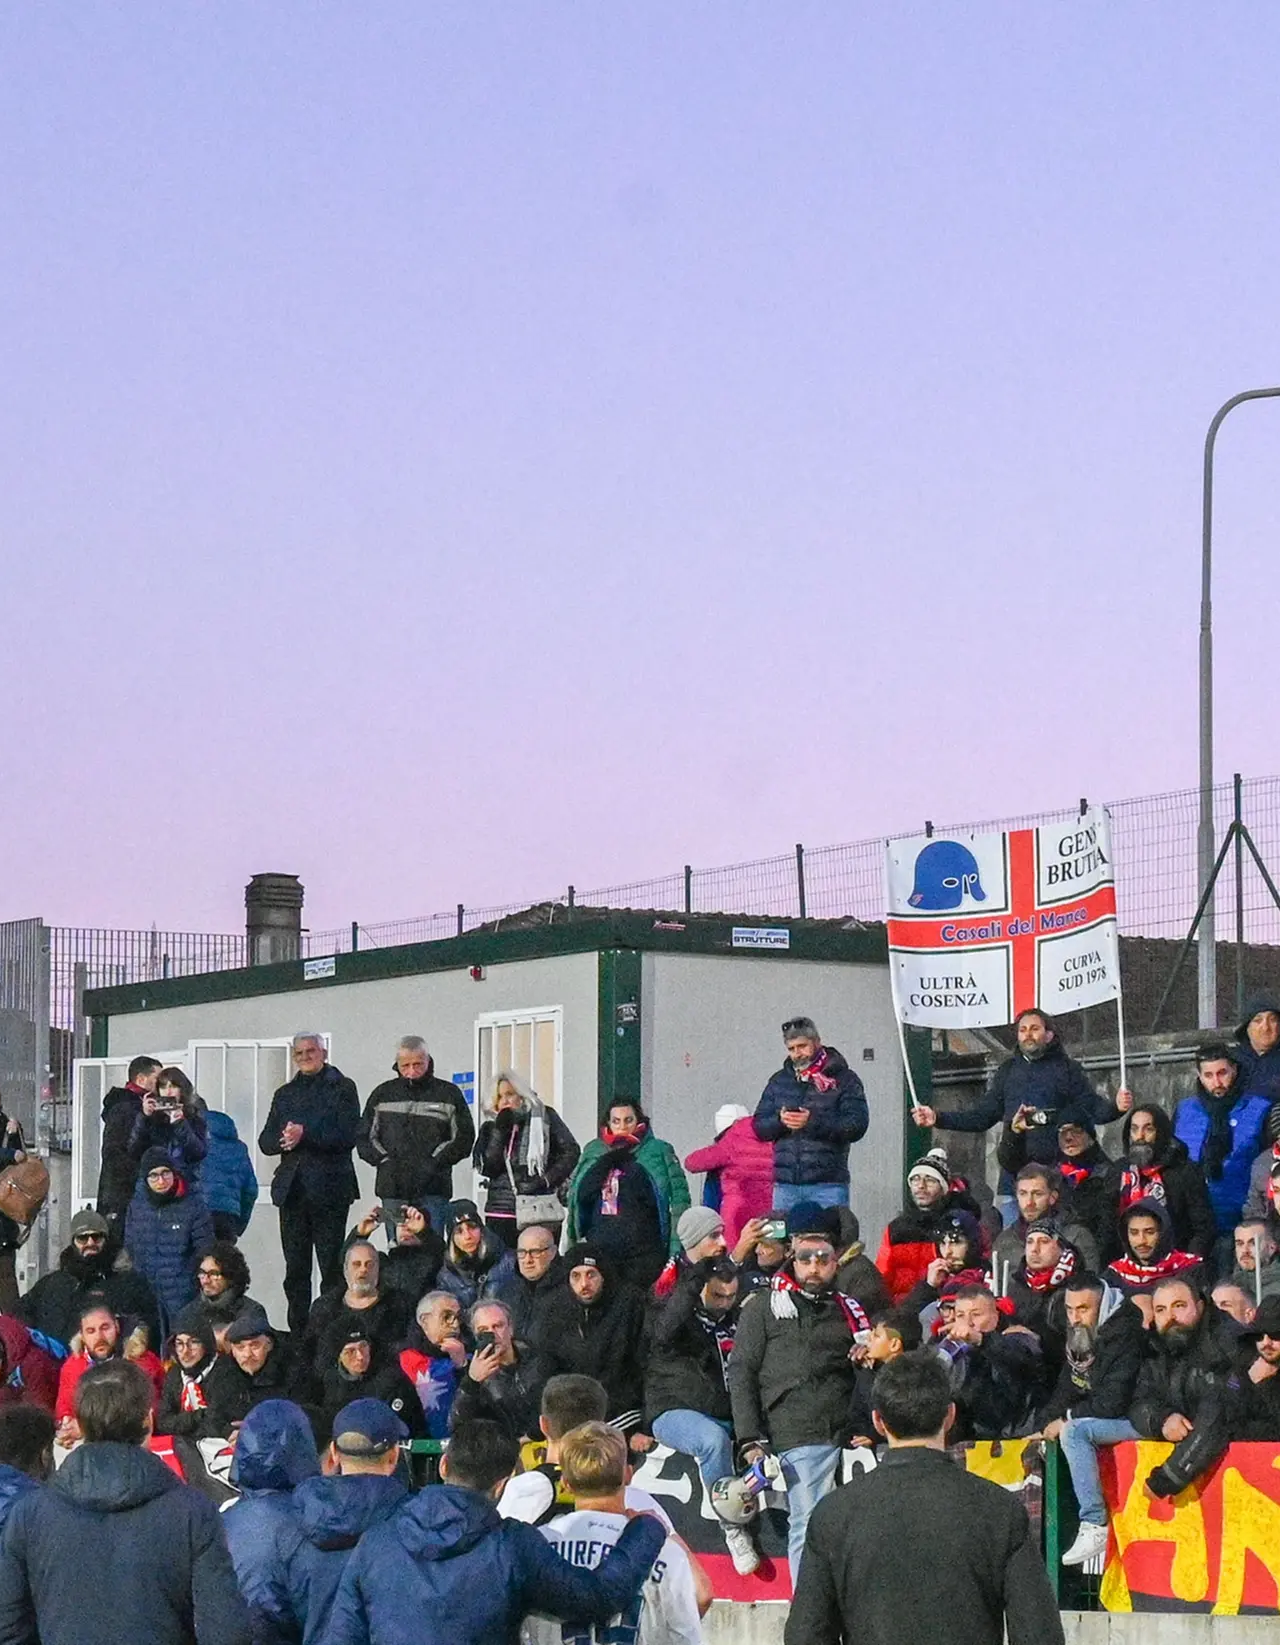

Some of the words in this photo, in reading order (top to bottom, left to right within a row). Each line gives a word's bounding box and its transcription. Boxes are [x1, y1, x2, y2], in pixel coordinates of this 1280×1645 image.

[1047, 847, 1109, 885] BRUTIA
[942, 921, 1002, 942] Casali
[1008, 917, 1035, 936] del
[1040, 908, 1088, 931] Manco
[1063, 950, 1102, 973] CURVA
[919, 972, 977, 990] ULTRÀ
[1058, 974, 1083, 992] SUD
[1086, 966, 1107, 989] 1978
[910, 992, 990, 1008] COSENZA
